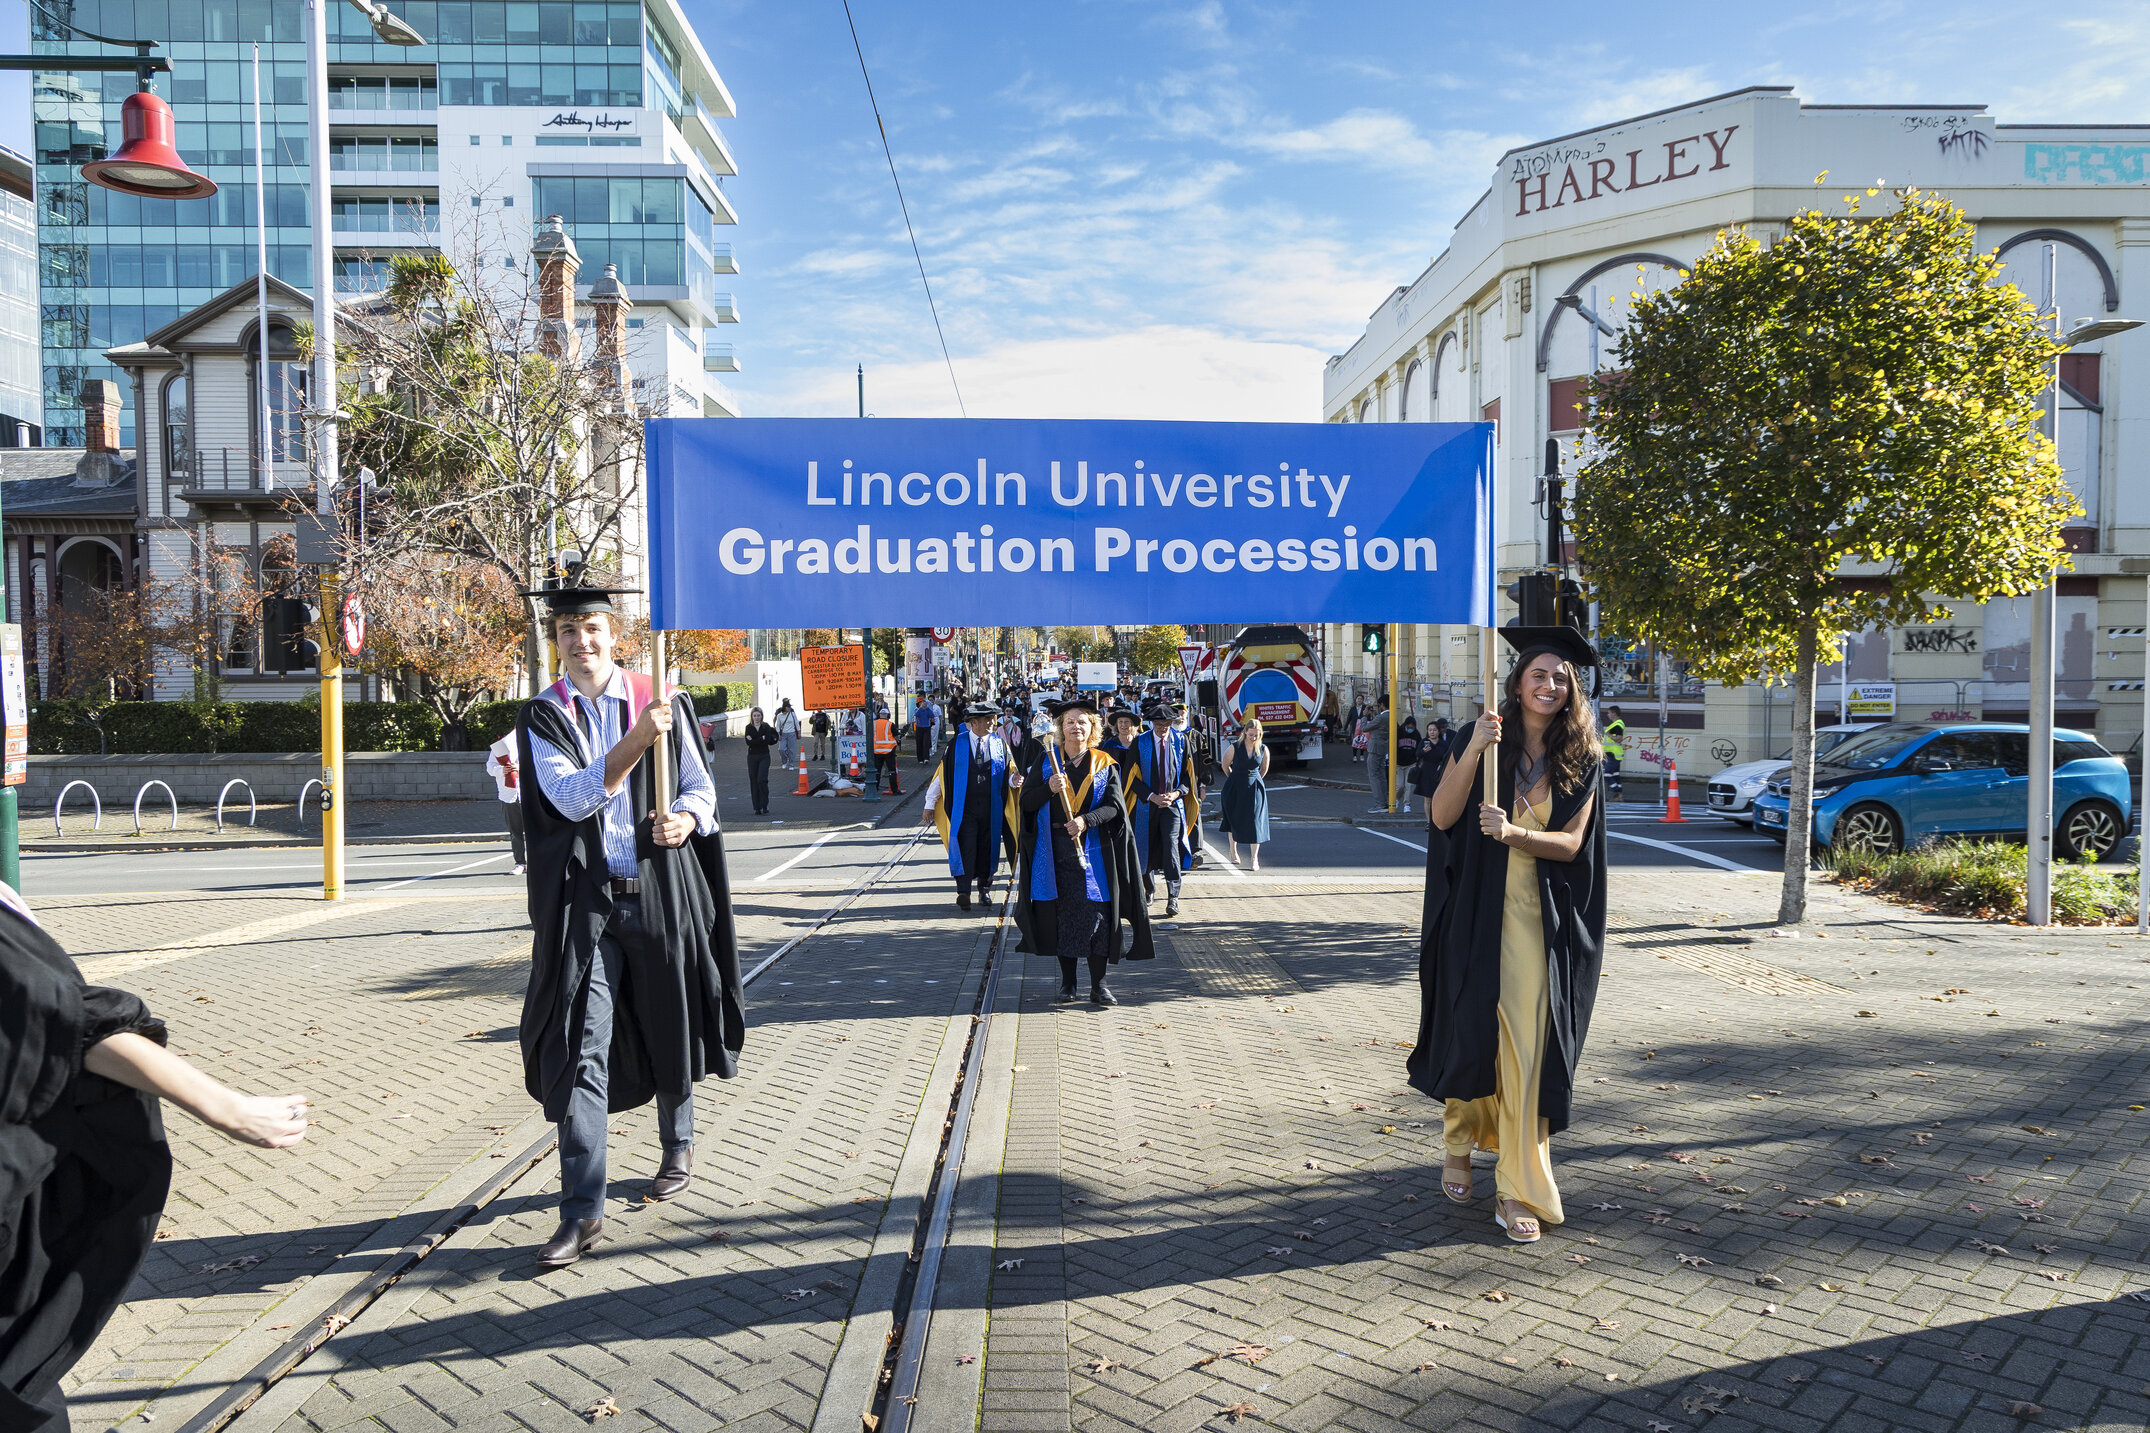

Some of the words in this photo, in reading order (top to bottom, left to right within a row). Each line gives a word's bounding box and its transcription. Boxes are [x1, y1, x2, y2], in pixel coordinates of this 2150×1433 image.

[542, 111, 593, 132] Anthony
[596, 112, 632, 131] Harper
[1515, 125, 1740, 217] HARLEY
[807, 458, 1027, 506] Lincoln
[1050, 459, 1351, 518] University
[718, 523, 1075, 575] Graduation
[1094, 525, 1438, 573] Procession
[936, 627, 949, 635] 30
[812, 647, 853, 656] TEMPORARY
[828, 654, 859, 663] CLOSURE
[1185, 653, 1195, 662] GIVE
